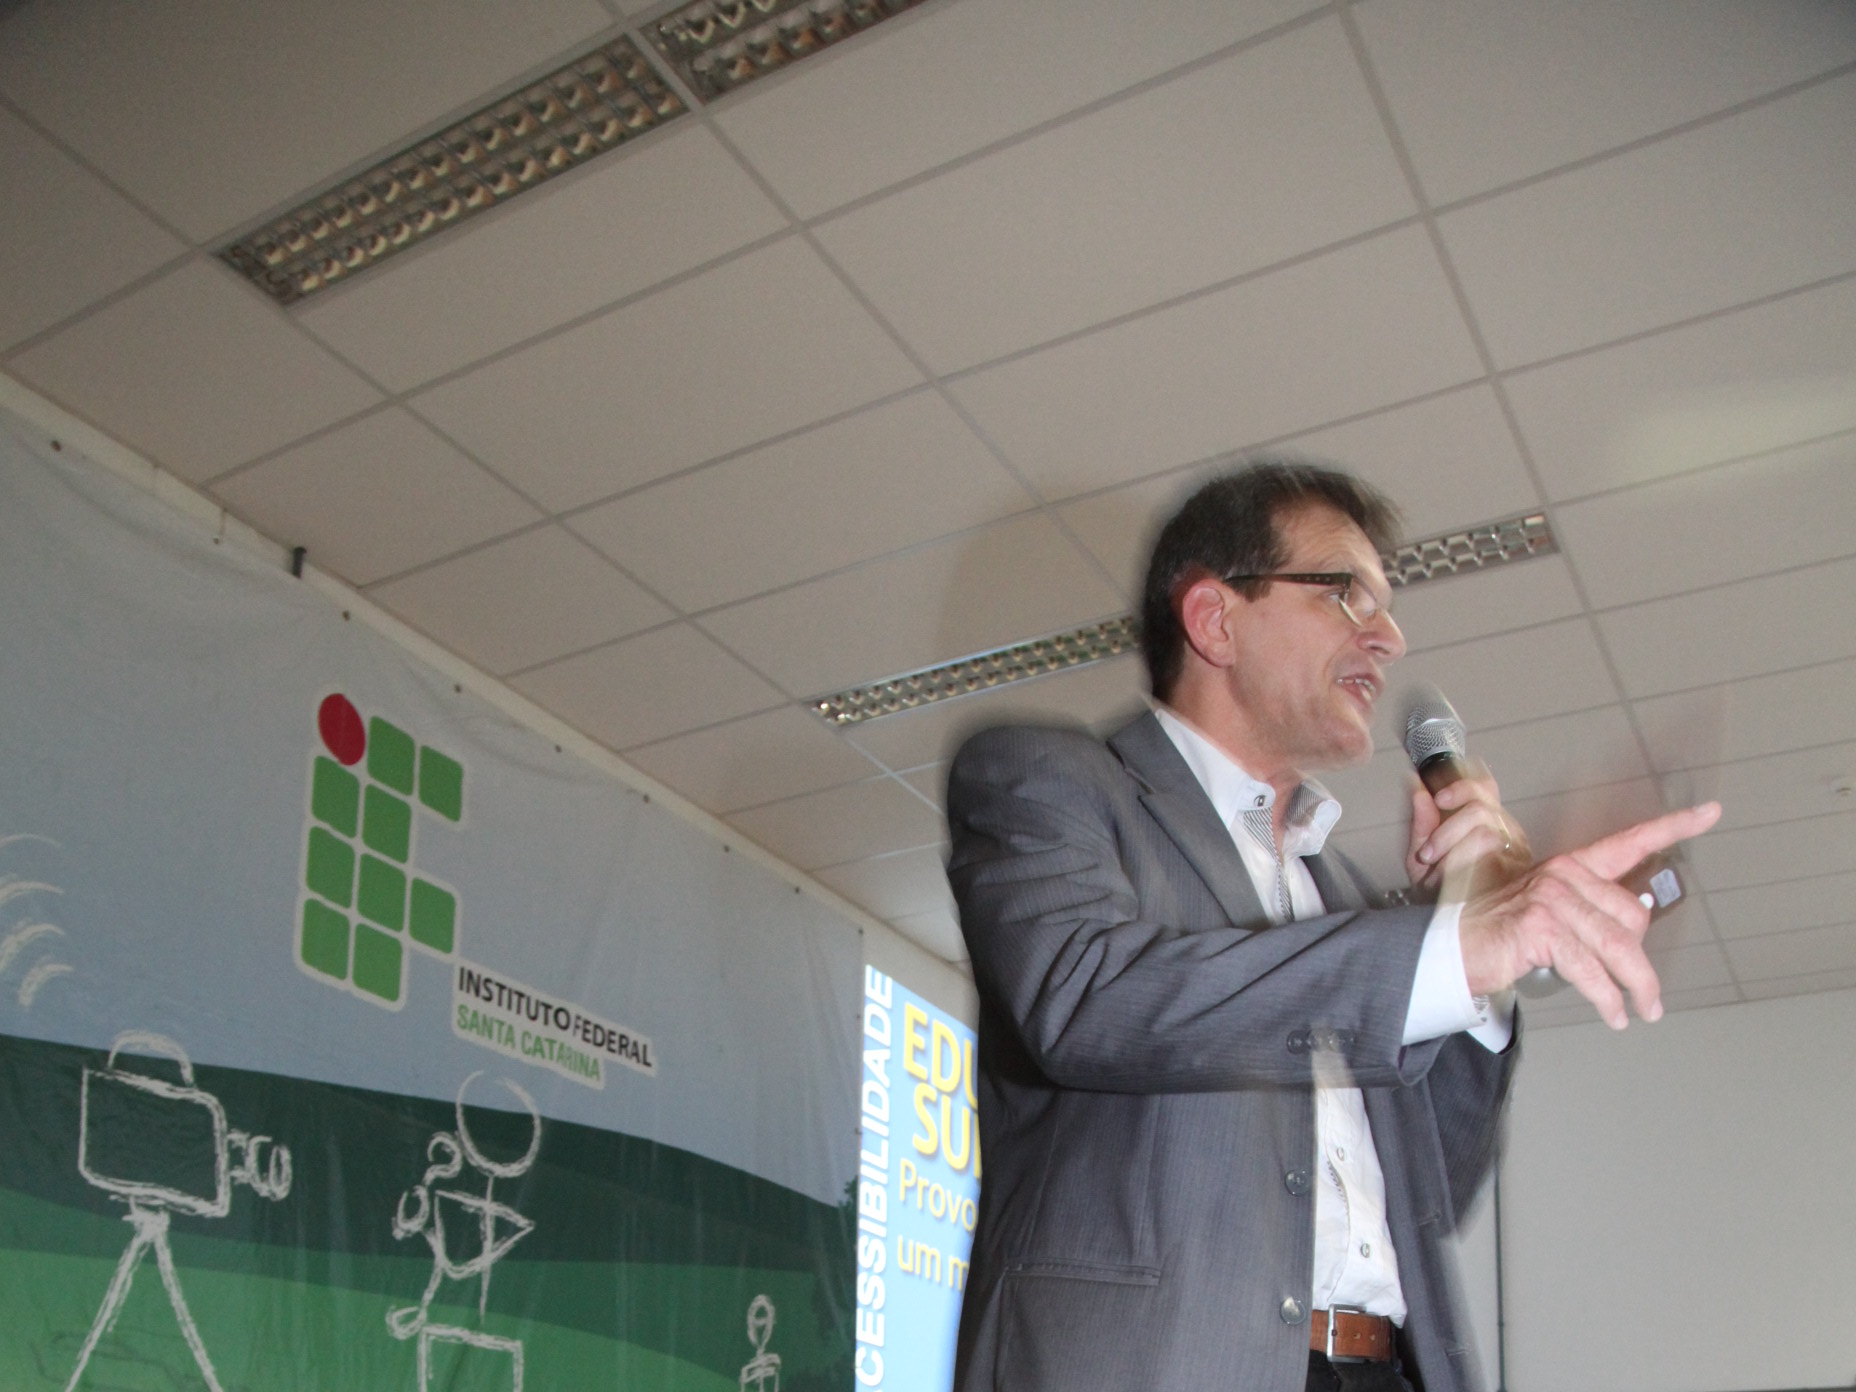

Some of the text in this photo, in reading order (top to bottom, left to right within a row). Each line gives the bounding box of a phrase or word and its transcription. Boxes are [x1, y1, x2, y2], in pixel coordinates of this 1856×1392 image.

[457, 1003, 600, 1082] SANTA CATARINA
[458, 966, 652, 1067] INSTITUTO FEDERAL
[899, 1157, 977, 1232] Provo
[897, 1235, 942, 1283] um
